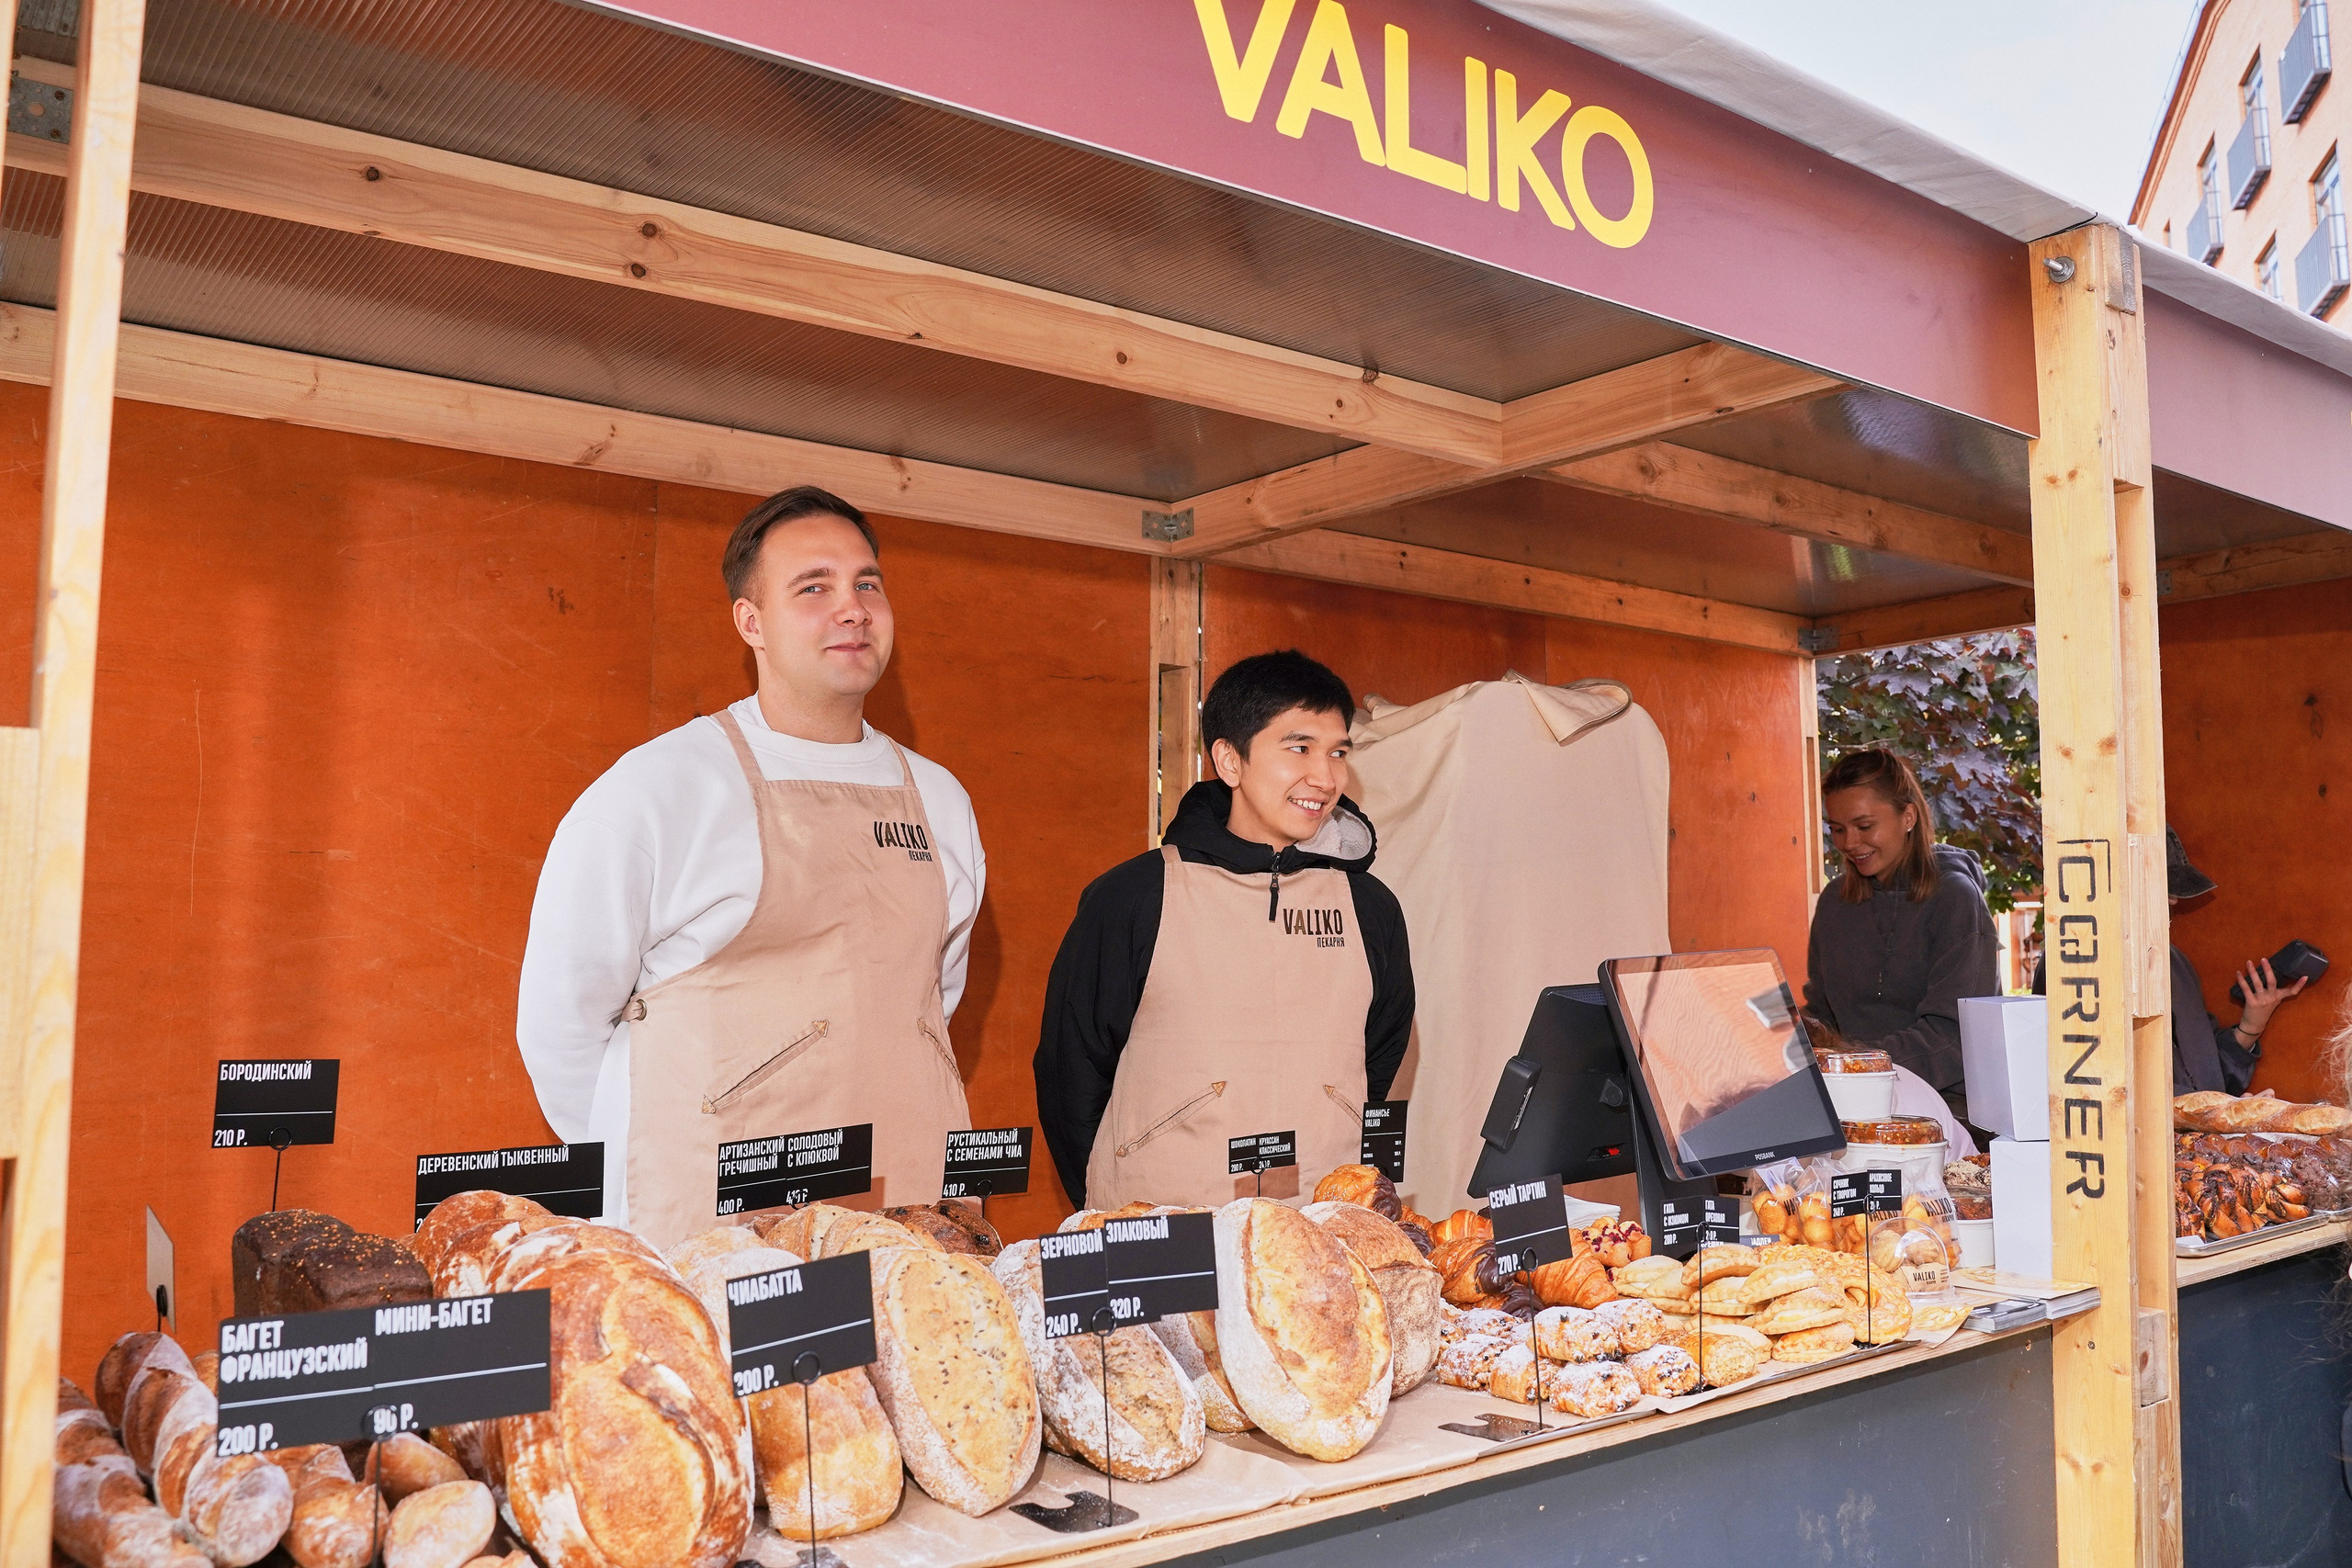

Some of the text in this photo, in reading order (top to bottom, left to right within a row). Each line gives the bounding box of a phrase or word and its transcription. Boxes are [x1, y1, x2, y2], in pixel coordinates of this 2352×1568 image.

[1194, 0, 1654, 248] VALIKO
[874, 821, 928, 850] VALIKO
[1283, 908, 1343, 935] VALIKO
[1317, 937, 1345, 947] ПЕКАРНЯ
[220, 1060, 312, 1082] БОРОДИНСКИЙ
[213, 1129, 248, 1146] 210 Р.
[718, 1136, 785, 1161] АРТИЗАНСКИЙ
[787, 1128, 843, 1152] СОЛОДОВЫЙ
[947, 1128, 1018, 1146] РУСТИКАЛЬНЫЙ
[418, 1151, 499, 1175] ДЕРЕВЕНСКИЙ
[501, 1145, 570, 1167] ТЫКВЕННЫЙ
[718, 1153, 778, 1177] ГРЕЧИШНЫЙ
[787, 1145, 840, 1168] С КЛЮКВОЙ
[946, 1145, 1023, 1162] С СЕМЕНАМИ ЧИА
[943, 1183, 967, 1197] 410 Р.
[1489, 1180, 1547, 1209] СЕРЫЙ ТАРТИН
[718, 1198, 745, 1214] 400 Р.
[1921, 1197, 1952, 1217] VALIKO
[1105, 1215, 1169, 1243] ЗЛАКОВЫЙ
[1040, 1228, 1103, 1259] ЗЕРНОВОЙ
[1498, 1253, 1521, 1275] 270 Р.
[1913, 1270, 1936, 1281] VALIKO
[728, 1269, 803, 1306] ЧИАБАТТА
[375, 1297, 494, 1336] МИНИ-БАГЕТ
[1132, 1296, 1145, 1317] Р.
[221, 1320, 285, 1354] БАГЕТ
[1046, 1313, 1082, 1338] 240 Р.
[220, 1337, 368, 1384] ФРАНЦУЗСКИЙ
[763, 1364, 779, 1389] Р.
[400, 1403, 419, 1430] Р.
[218, 1422, 279, 1457] 200 Р.
